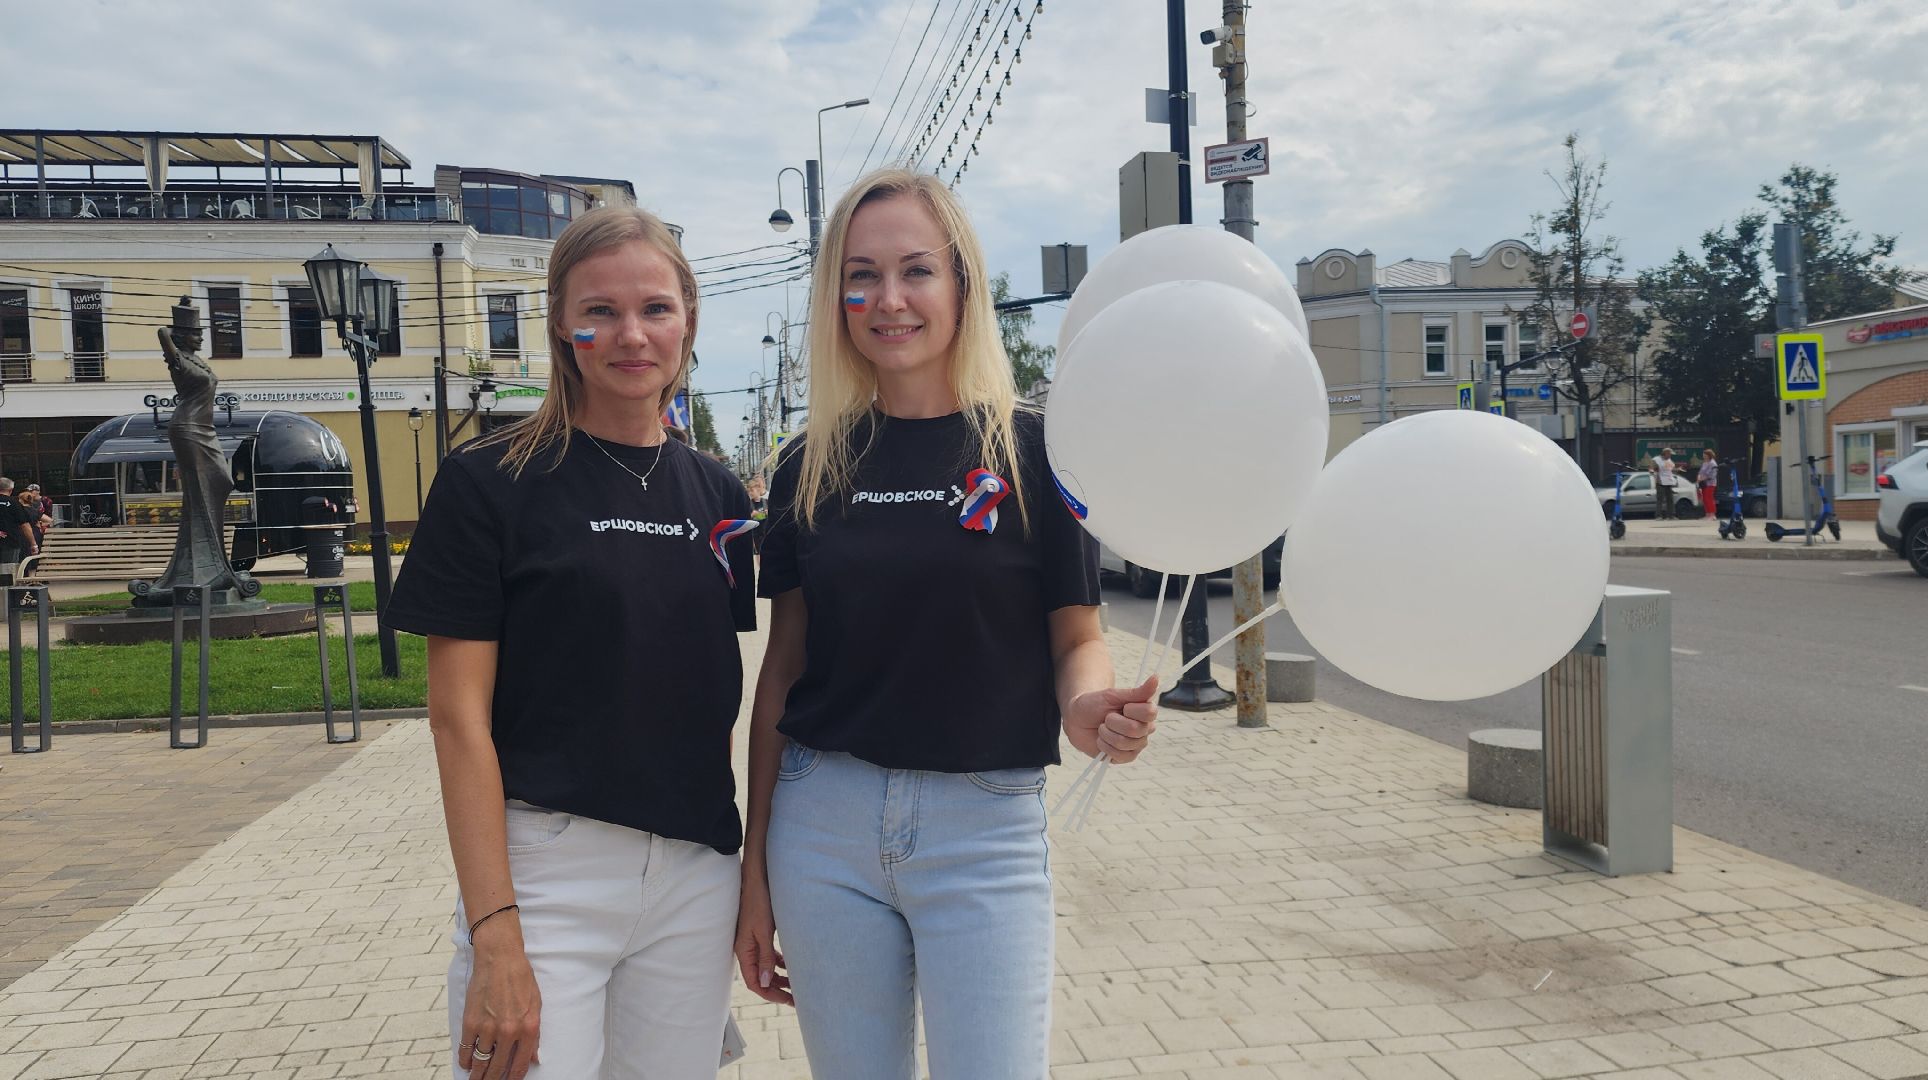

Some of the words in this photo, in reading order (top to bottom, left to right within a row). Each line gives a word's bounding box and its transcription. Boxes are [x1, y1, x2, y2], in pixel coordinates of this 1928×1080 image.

[73, 292, 101, 304] КИНО
[243, 391, 344, 402] КОНДИТЕРСКАЯ
[369, 391, 405, 400] ИЦЦА
[852, 489, 946, 504] ЕРШОВСКОЕ
[88, 513, 112, 525] Coffee
[589, 518, 684, 536] ЕРШОВСКОЕ
